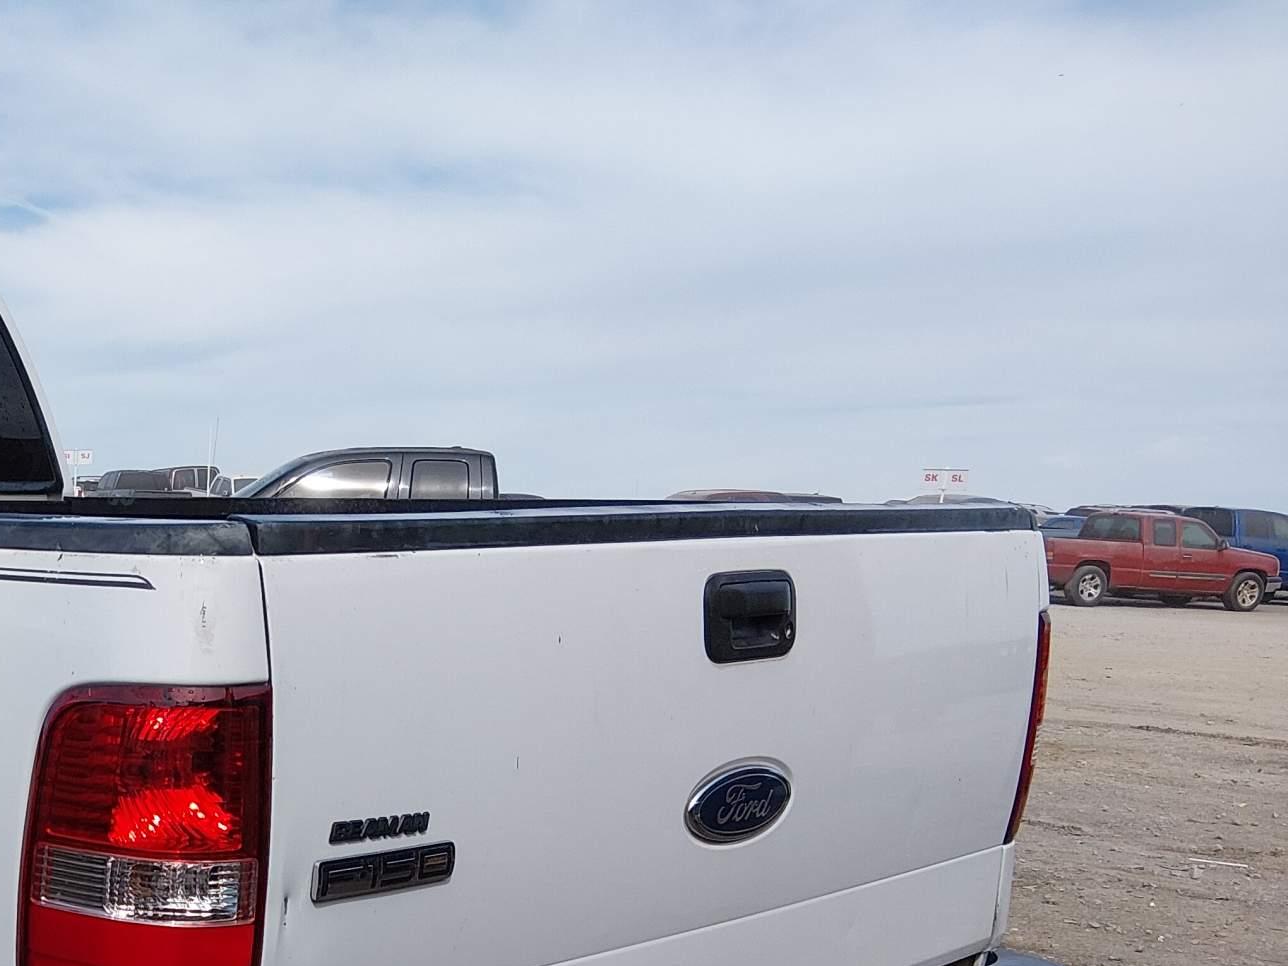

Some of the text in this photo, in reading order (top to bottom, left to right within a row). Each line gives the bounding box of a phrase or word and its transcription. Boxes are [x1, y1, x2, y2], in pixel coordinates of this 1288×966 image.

[924, 473, 939, 482] SK
[951, 474, 964, 482] SL
[717, 782, 774, 825] Ford
[329, 811, 430, 845] BEAMAN
